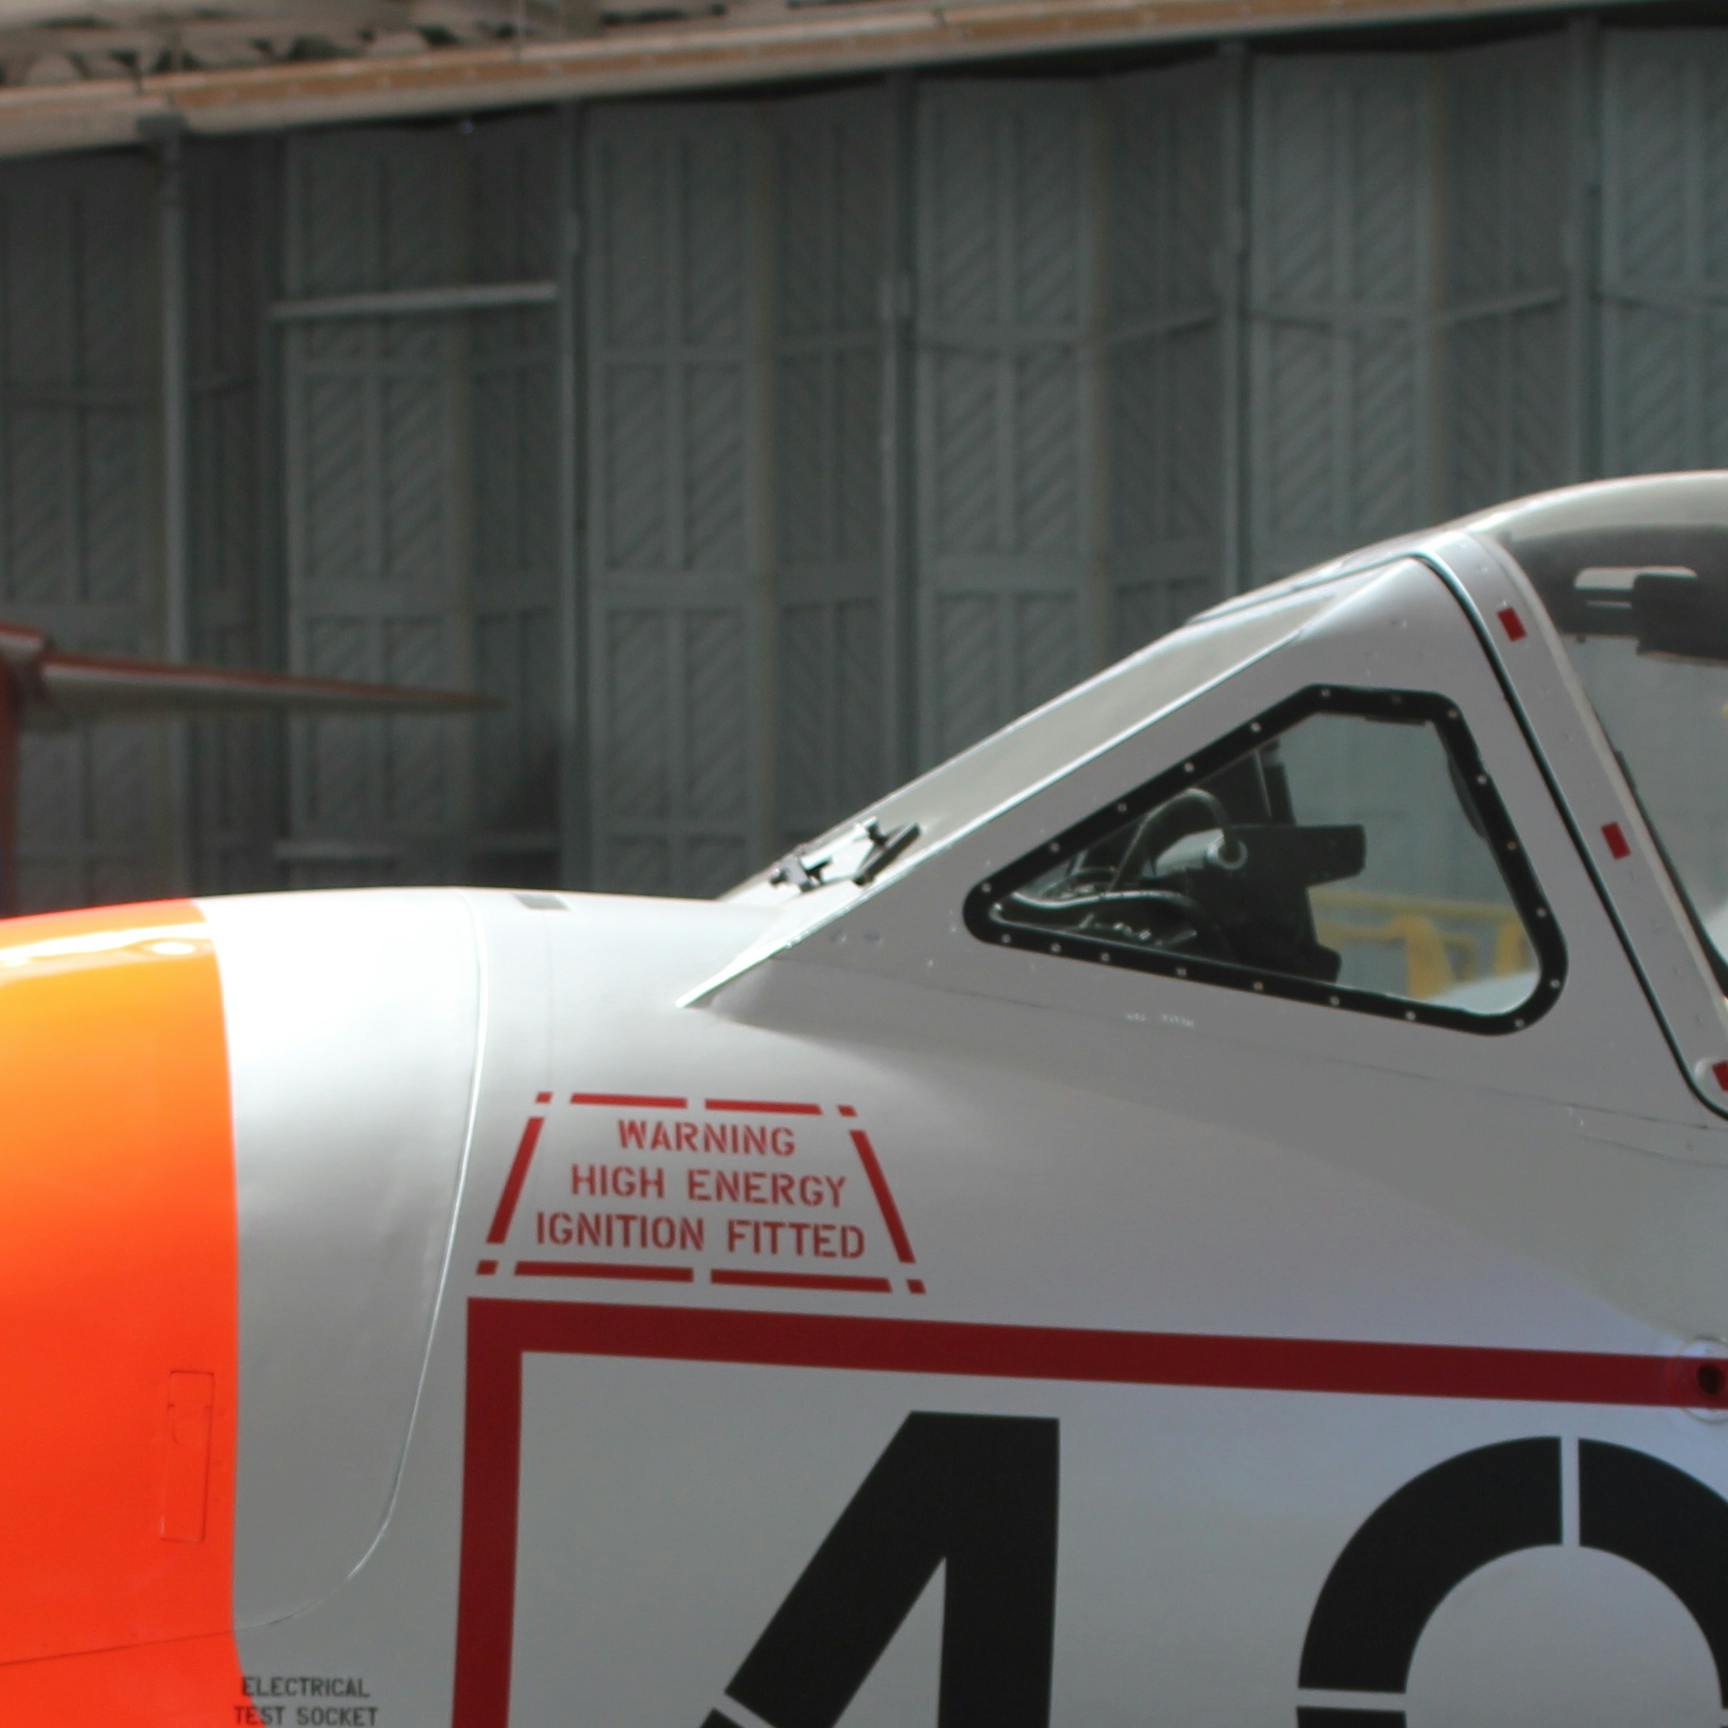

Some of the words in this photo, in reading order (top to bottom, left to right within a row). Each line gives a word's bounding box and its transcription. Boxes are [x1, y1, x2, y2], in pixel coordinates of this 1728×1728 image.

[618, 1120, 795, 1156] WARNING
[572, 1163, 665, 1199] HIGH
[688, 1168, 846, 1208] ENERGY
[535, 1211, 705, 1251] IGNITION
[727, 1218, 865, 1259] FITTED
[241, 1676, 371, 1698] ELECTRICAL
[233, 1706, 286, 1726] TEST
[296, 1706, 379, 1728] SOCKET
